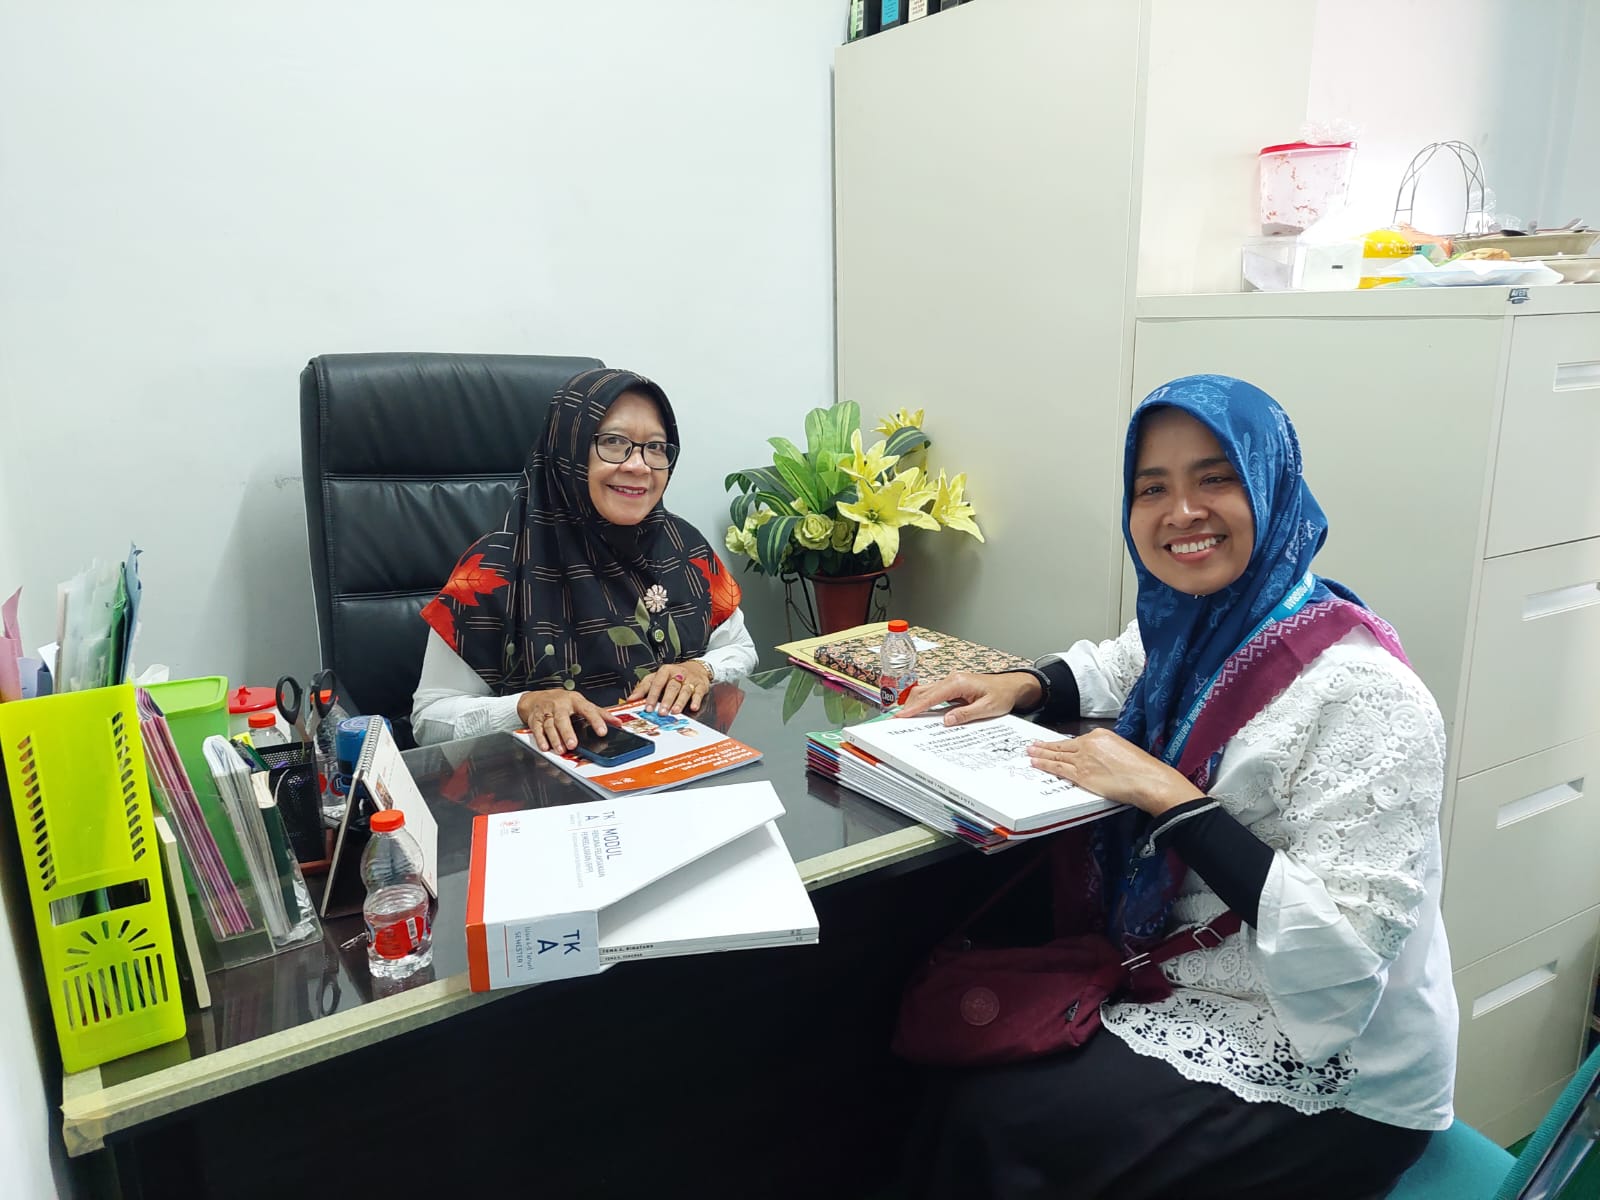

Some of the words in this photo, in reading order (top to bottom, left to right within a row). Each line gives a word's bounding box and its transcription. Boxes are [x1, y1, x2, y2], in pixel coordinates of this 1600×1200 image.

[1188, 699, 1205, 723] SCHOOL
[602, 810, 616, 821] TK
[602, 828, 623, 861] MODUL
[514, 931, 524, 964] SEMESTER
[537, 939, 559, 955] A
[563, 929, 581, 955] TK
